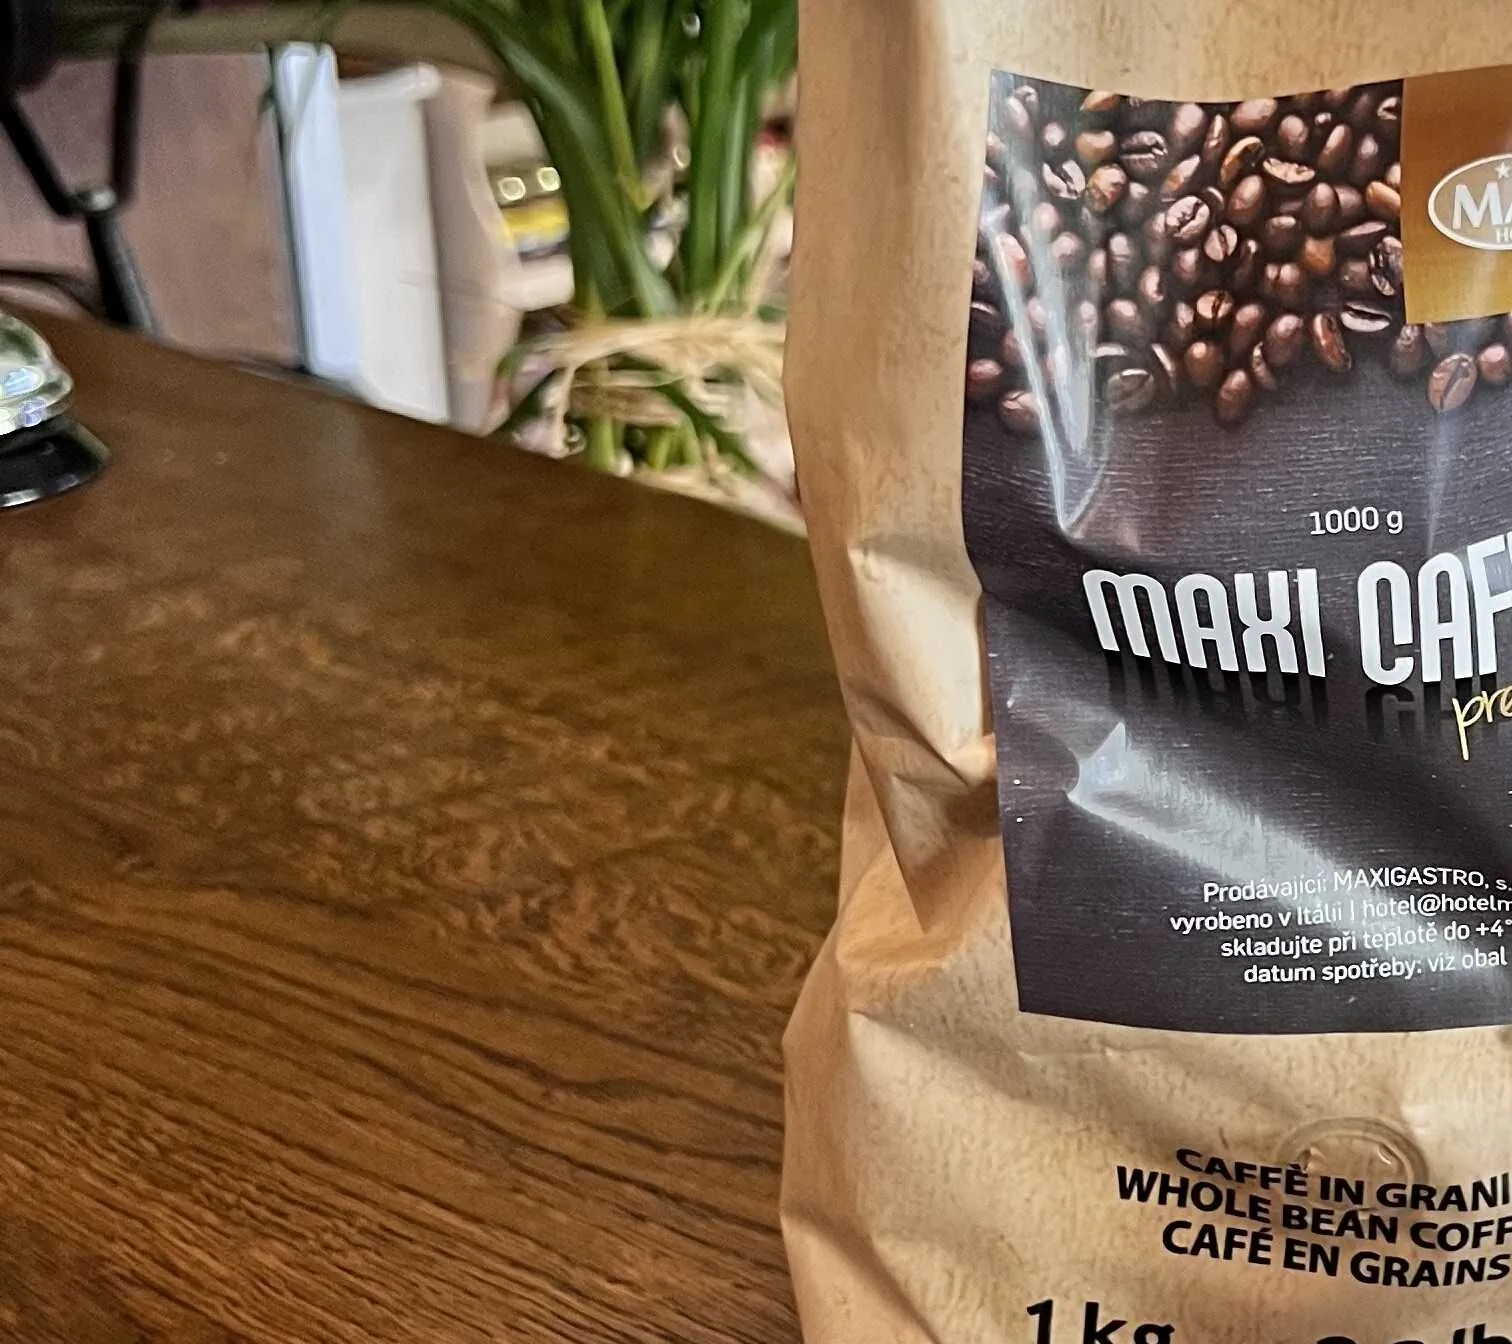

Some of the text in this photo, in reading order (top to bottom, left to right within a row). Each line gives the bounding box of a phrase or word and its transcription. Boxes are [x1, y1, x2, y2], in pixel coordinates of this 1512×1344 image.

[1309, 506, 1403, 536] 1000 g
[1082, 568, 1326, 677] MAXI
[1203, 875, 1327, 903] Prodávající:
[1333, 866, 1489, 893] MAXIGASTRO,
[1170, 906, 1273, 935] vyrobeno
[1278, 912, 1291, 927] v
[1297, 902, 1342, 926] Itálii
[1220, 934, 1323, 958] skladujte
[1328, 930, 1356, 957] při
[1362, 924, 1438, 950] teplotě
[1443, 921, 1470, 940] do
[1243, 965, 1316, 983] datum
[1321, 956, 1424, 985] spotřeby:
[1461, 946, 1508, 969] obal
[1175, 1148, 1511, 1213] CAFFÈ IN GRANI
[1115, 1165, 1272, 1224] WHOLE
[1281, 1204, 1398, 1244] BEAN
[1162, 1220, 1511, 1288] CAFÉ EN GRAINS
